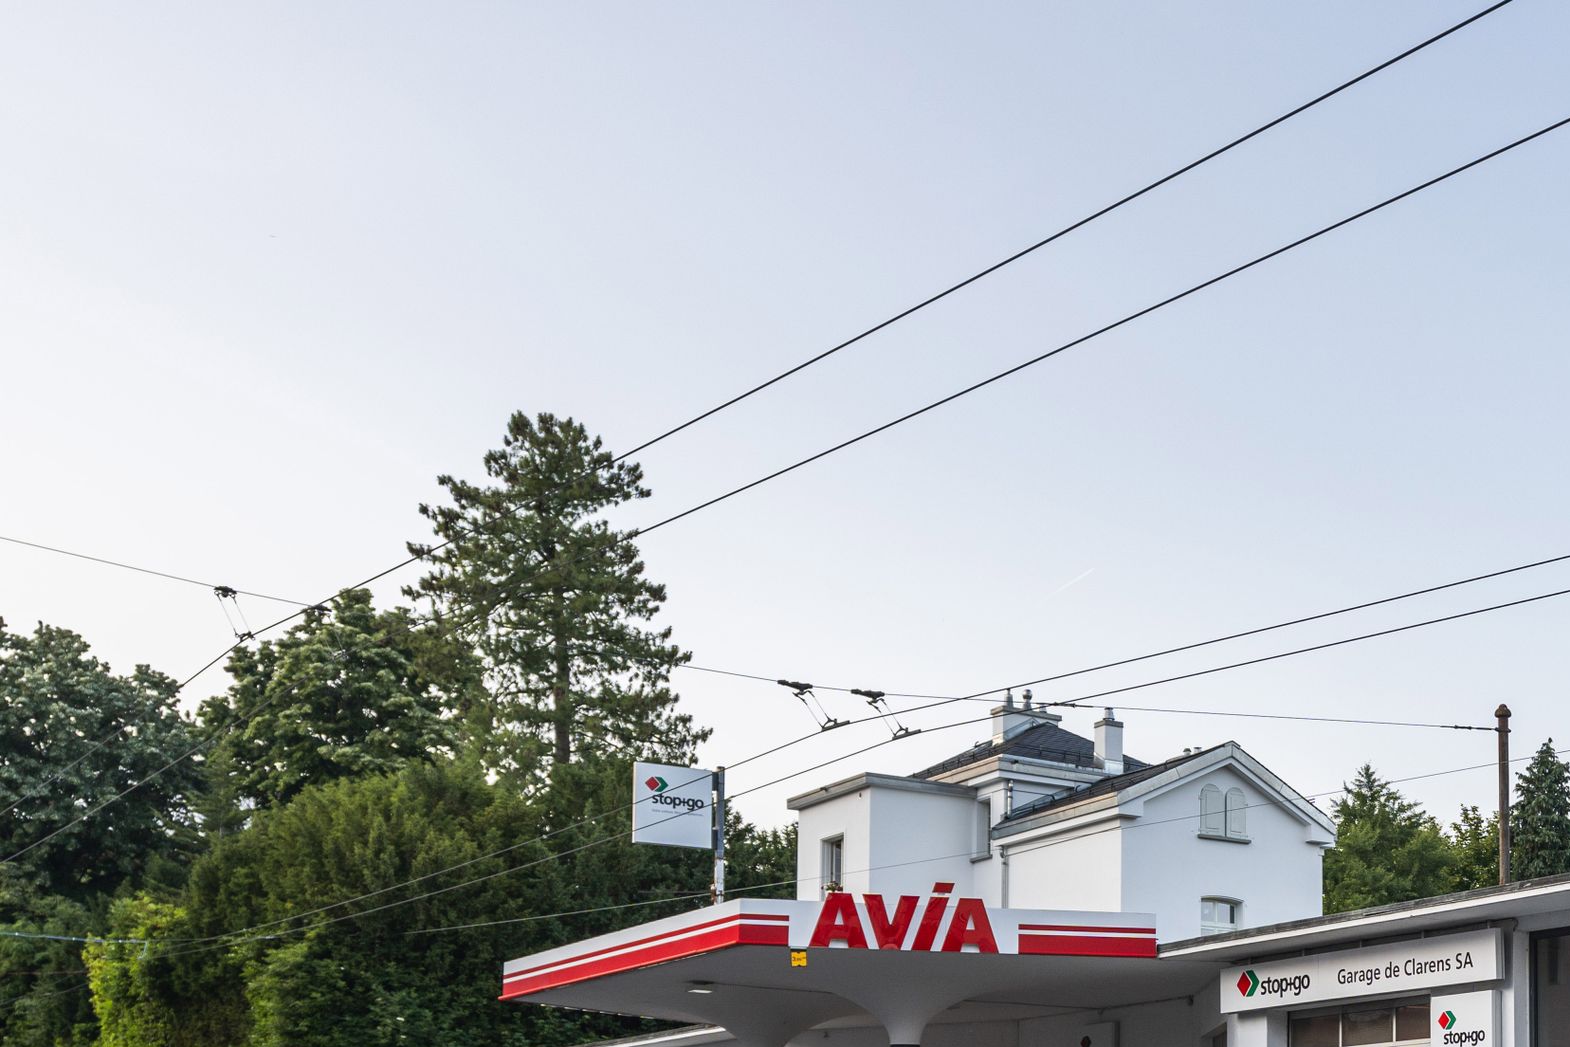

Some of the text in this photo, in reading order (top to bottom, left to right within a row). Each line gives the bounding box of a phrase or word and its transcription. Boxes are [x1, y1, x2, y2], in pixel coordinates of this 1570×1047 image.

[1337, 951, 1474, 986] Garage de Clarens SA
[1260, 974, 1310, 998] stop+go
[1443, 1029, 1486, 1047] stop+go
